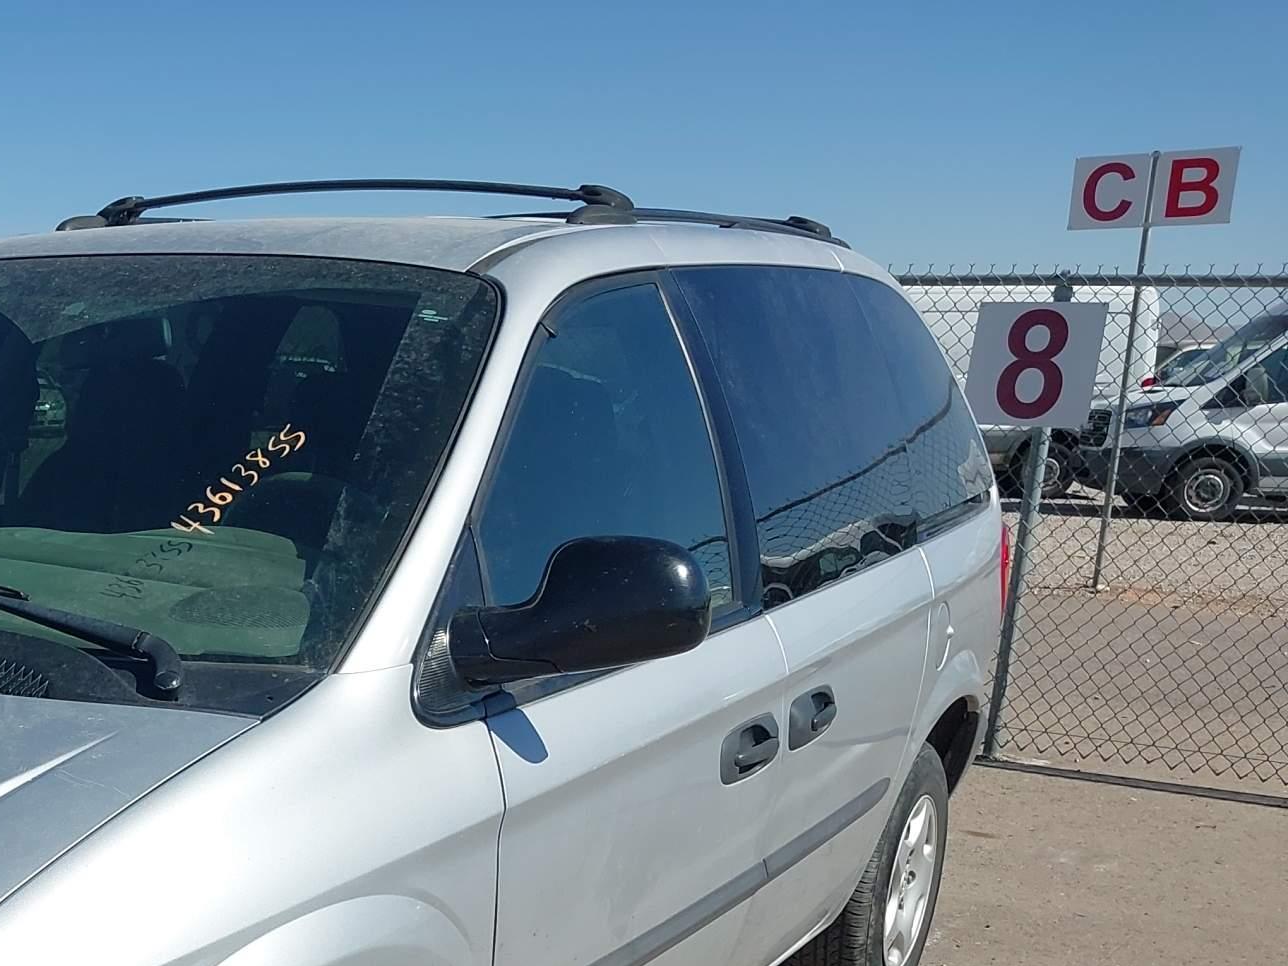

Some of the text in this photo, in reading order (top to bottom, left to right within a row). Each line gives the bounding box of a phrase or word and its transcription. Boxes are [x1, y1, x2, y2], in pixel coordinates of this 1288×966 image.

[1082, 162, 1136, 222] C
[1164, 157, 1221, 218] B
[996, 308, 1069, 419] 8
[170, 423, 306, 535] 43613855
